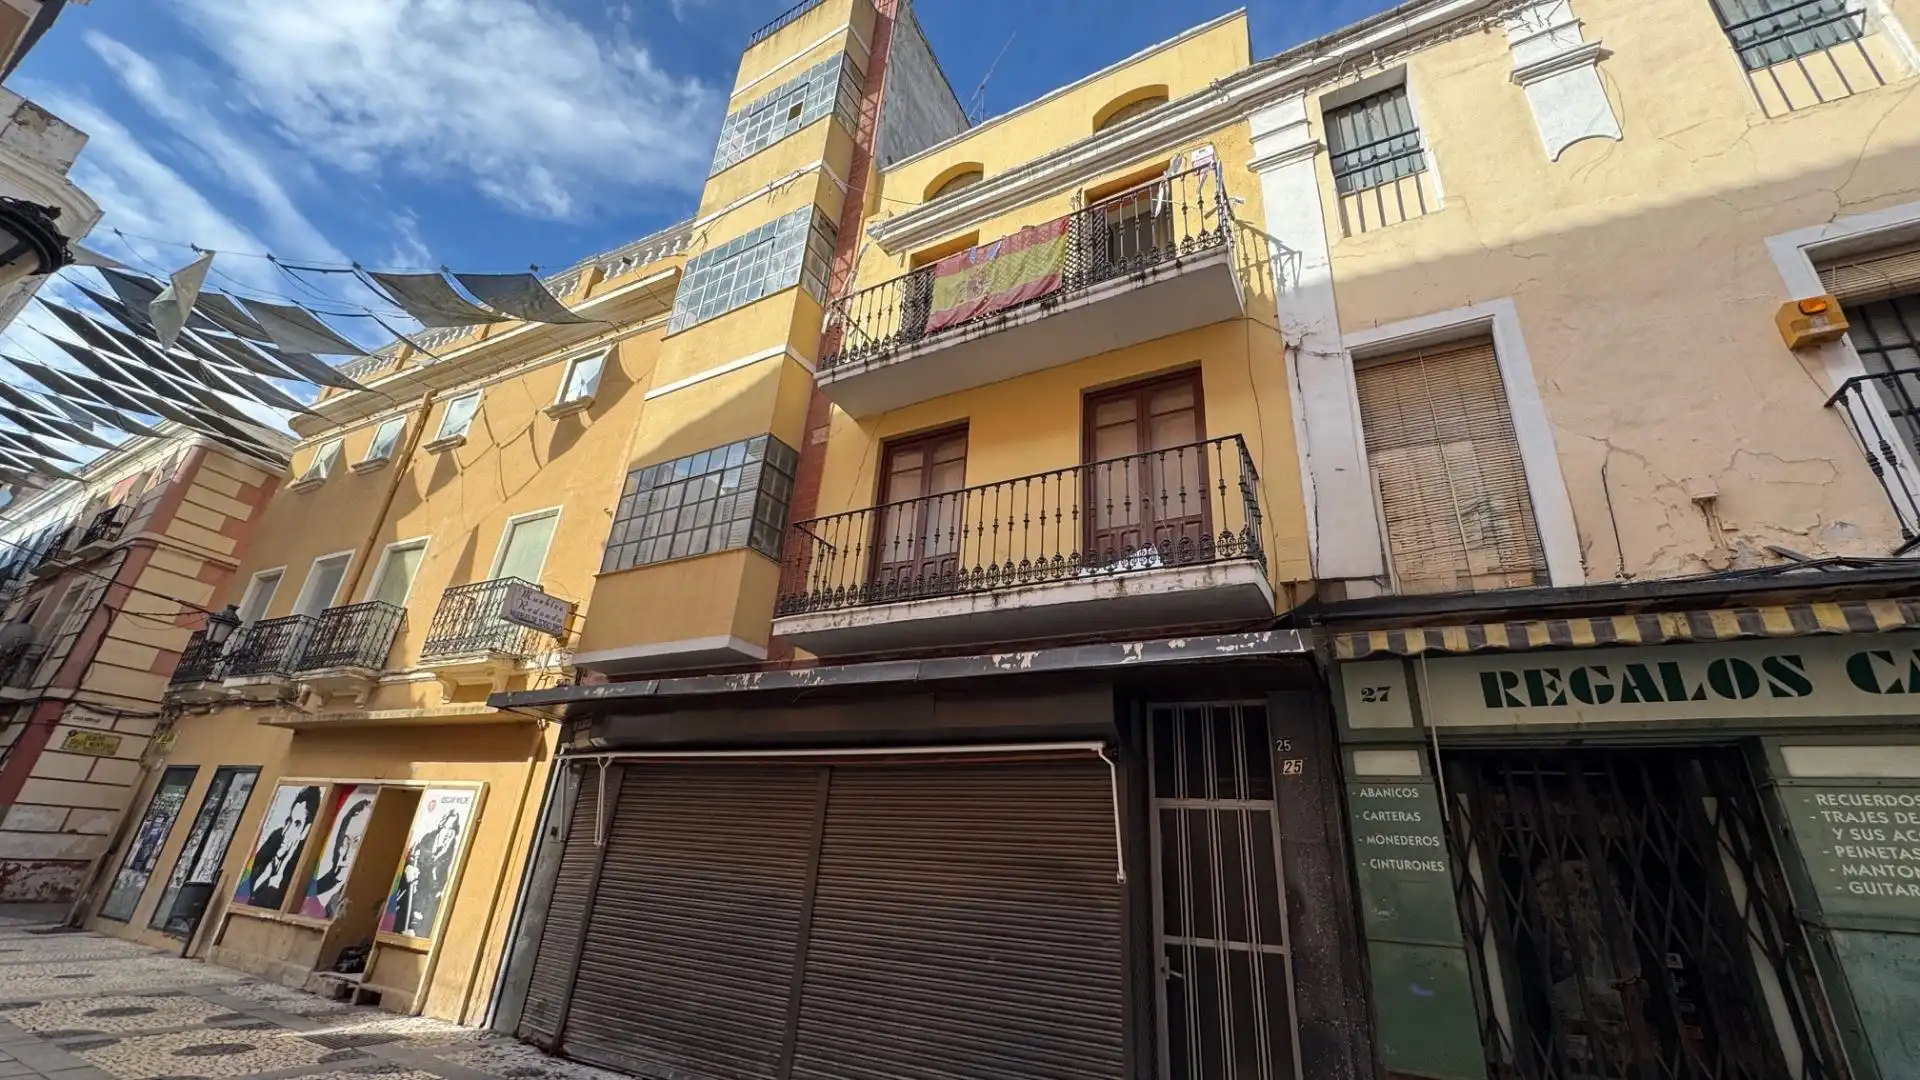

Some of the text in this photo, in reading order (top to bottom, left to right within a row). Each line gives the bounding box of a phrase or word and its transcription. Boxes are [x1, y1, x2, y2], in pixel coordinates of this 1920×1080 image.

[1479, 650, 1920, 709] REGALOS C
[1361, 685, 1392, 703] 27
[1276, 739, 1292, 752] 25
[1284, 760, 1302, 774] 25
[1360, 787, 1419, 799] ABANICOS
[1362, 810, 1421, 822] CARTERAS
[1821, 810, 1920, 825] TRAJES DE
[1366, 834, 1440, 847] MONEDEROS
[1832, 828, 1920, 842] Y SUS AC
[1834, 845, 1920, 860] PEINETAS
[1369, 858, 1445, 872] CINTURONES
[1848, 881, 1920, 897] GUITAR
